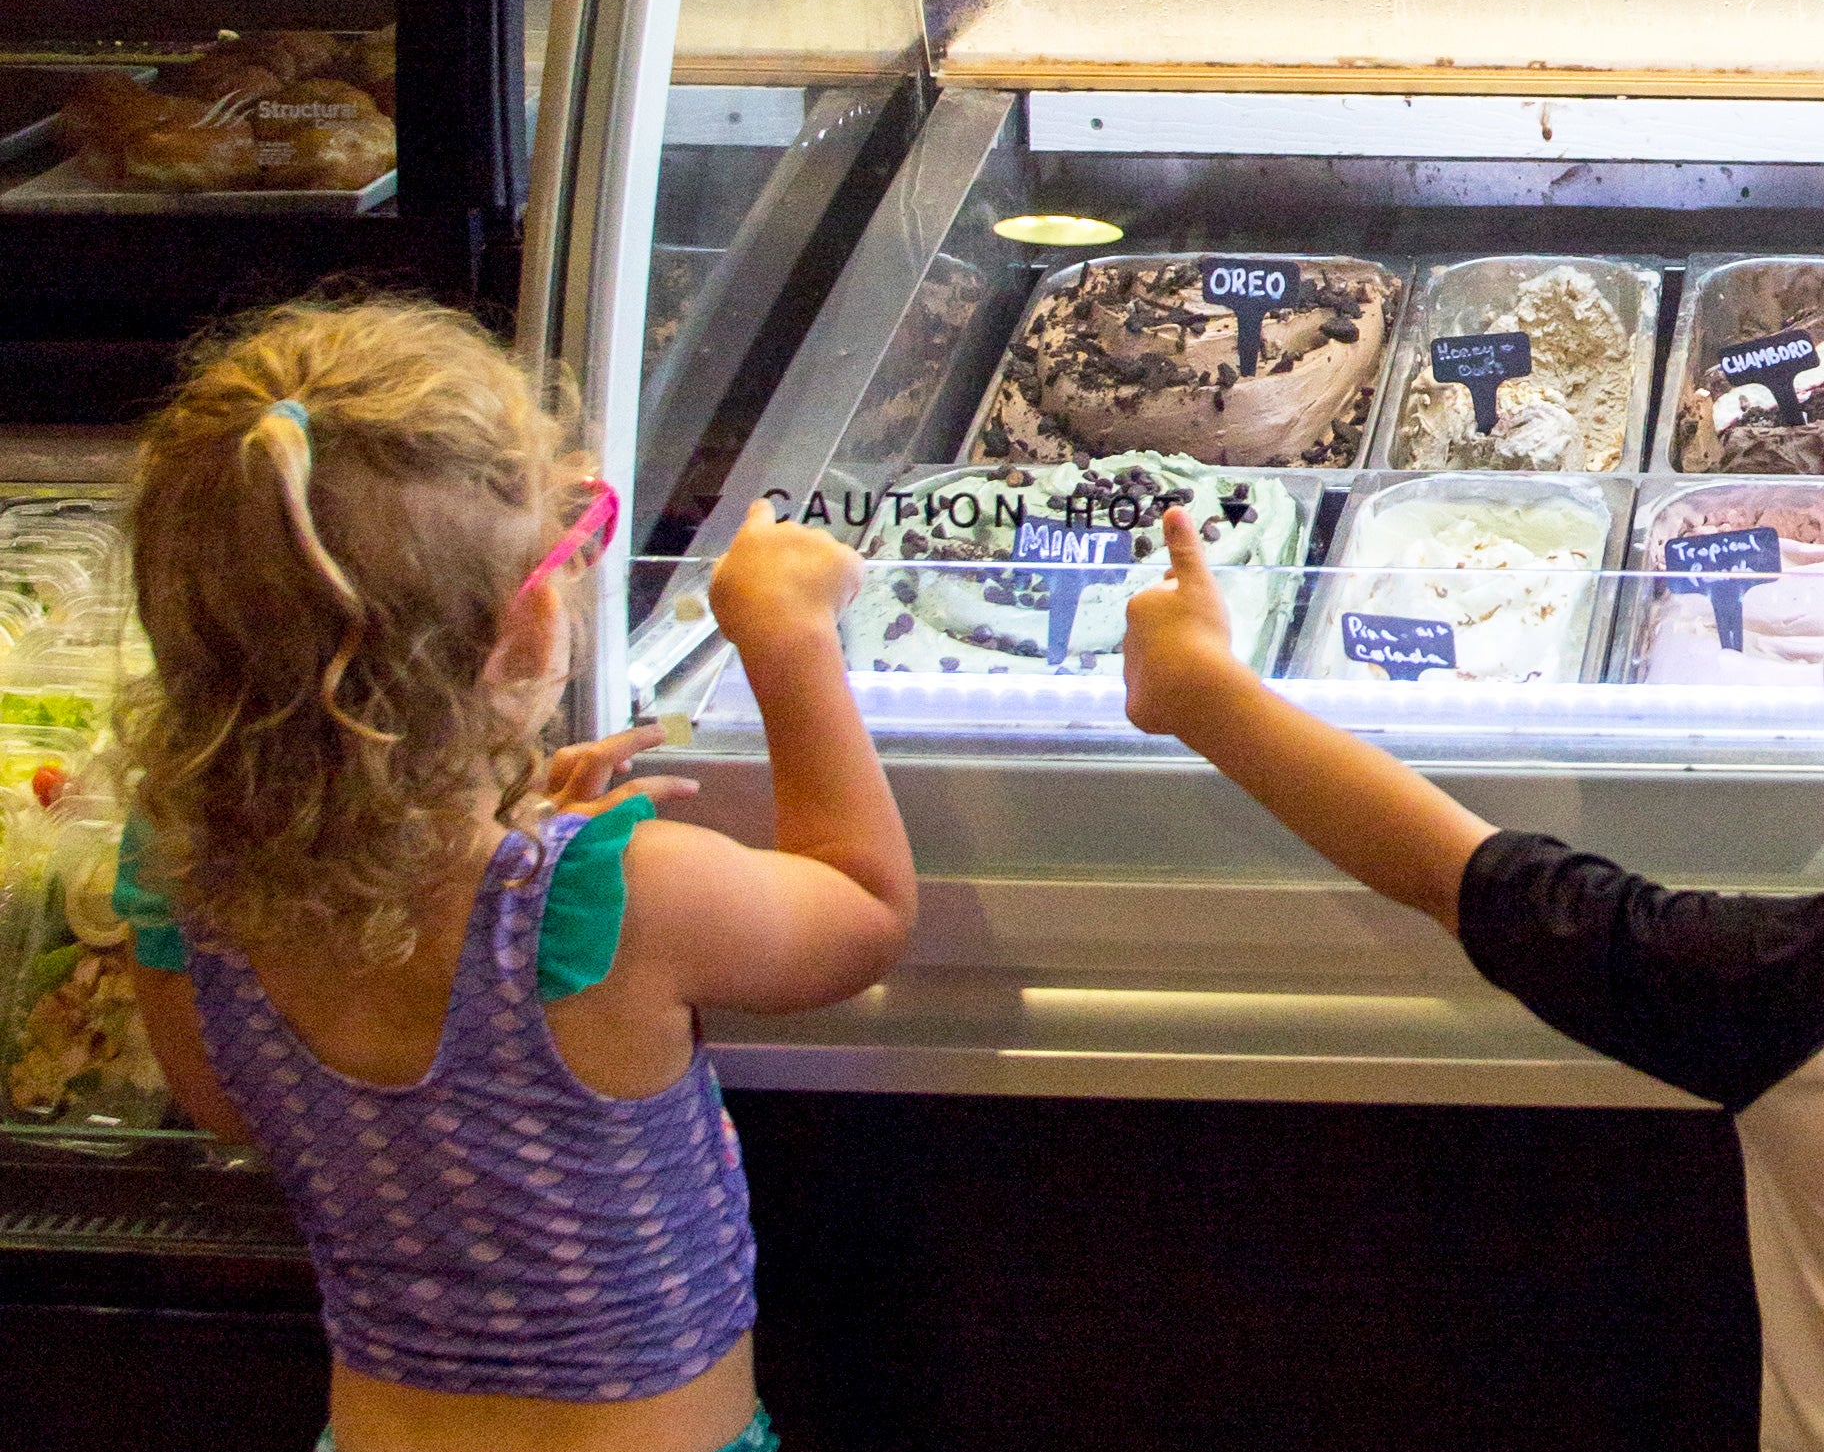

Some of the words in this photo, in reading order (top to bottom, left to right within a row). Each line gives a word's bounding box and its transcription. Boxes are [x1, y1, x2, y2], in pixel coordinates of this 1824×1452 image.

[1210, 267, 1286, 300] OREO
[1721, 339, 1814, 374] CHAMBORD
[763, 488, 1025, 530] CAUTION
[1017, 521, 1119, 564] MINT
[1671, 533, 1761, 563] Tropical
[1355, 643, 1449, 666] Colada
